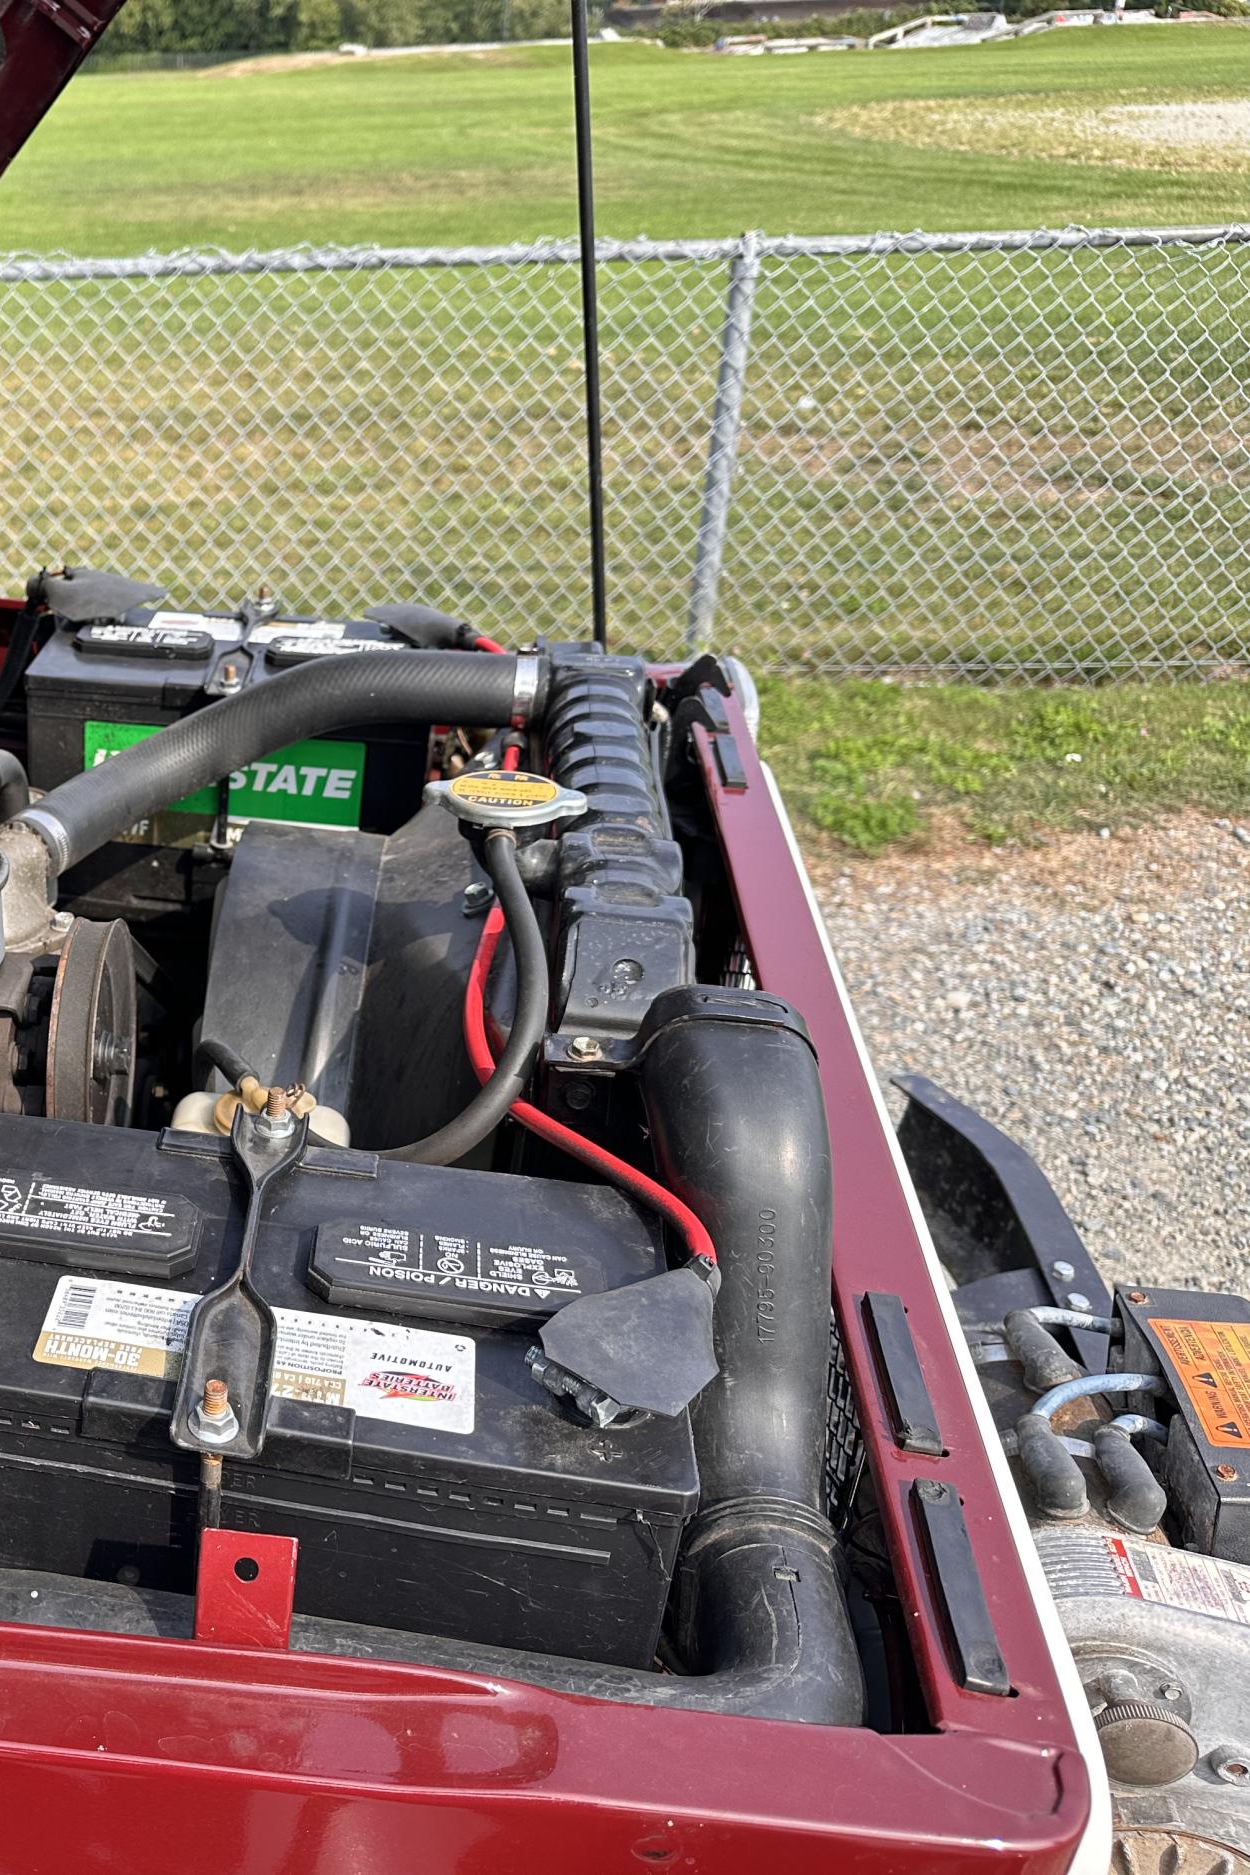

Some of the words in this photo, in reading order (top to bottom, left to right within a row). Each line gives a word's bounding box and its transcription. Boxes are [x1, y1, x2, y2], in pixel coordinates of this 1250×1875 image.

[468, 795, 534, 806] CAUTION
[38, 1209, 88, 1221] IMMEDIATELY
[105, 1208, 140, 1217] MEDICAL
[110, 1220, 136, 1228] FLUSH
[116, 1215, 137, 1223] WITH
[359, 1224, 382, 1232] BURNS
[383, 1228, 409, 1236] SEVERE
[342, 1236, 362, 1244] ACID
[369, 1235, 391, 1243] CAUSE
[372, 1231, 408, 1240] BLINDNESS
[434, 1235, 464, 1243] SMOKING
[363, 1239, 408, 1251] SULFURIC
[437, 1245, 465, 1253] SPARKS
[438, 1240, 465, 1248] FLAMES
[507, 1244, 532, 1252] INJURY
[489, 1247, 527, 1257] BLINDNESS
[527, 1252, 551, 1260] CAUSE
[493, 1258, 544, 1271] EXPLOSIVE
[511, 1256, 543, 1265] GASES
[368, 1265, 435, 1283] POISON
[488, 1269, 522, 1280] SHIELD
[497, 1265, 523, 1274] EYES
[756, 1207, 777, 1345] 17795-90300
[454, 1276, 530, 1296] DANGER
[47, 1332, 115, 1348] REPLACEMENT
[300, 1338, 308, 1346] by
[118, 1343, 142, 1353] FREE
[309, 1341, 345, 1352] Distributed
[43, 1339, 141, 1366] 30-MONTH
[369, 1352, 452, 1372] AUTOMOTIVE
[287, 1362, 342, 1374] PROPOSITION
[283, 1372, 295, 1381] CA
[304, 1376, 322, 1386] 710
[369, 1372, 453, 1391] BATTERIES
[323, 1379, 342, 1388] CCA
[361, 1378, 453, 1400] INTERSTATE
[1206, 1390, 1228, 1419] WARNING
